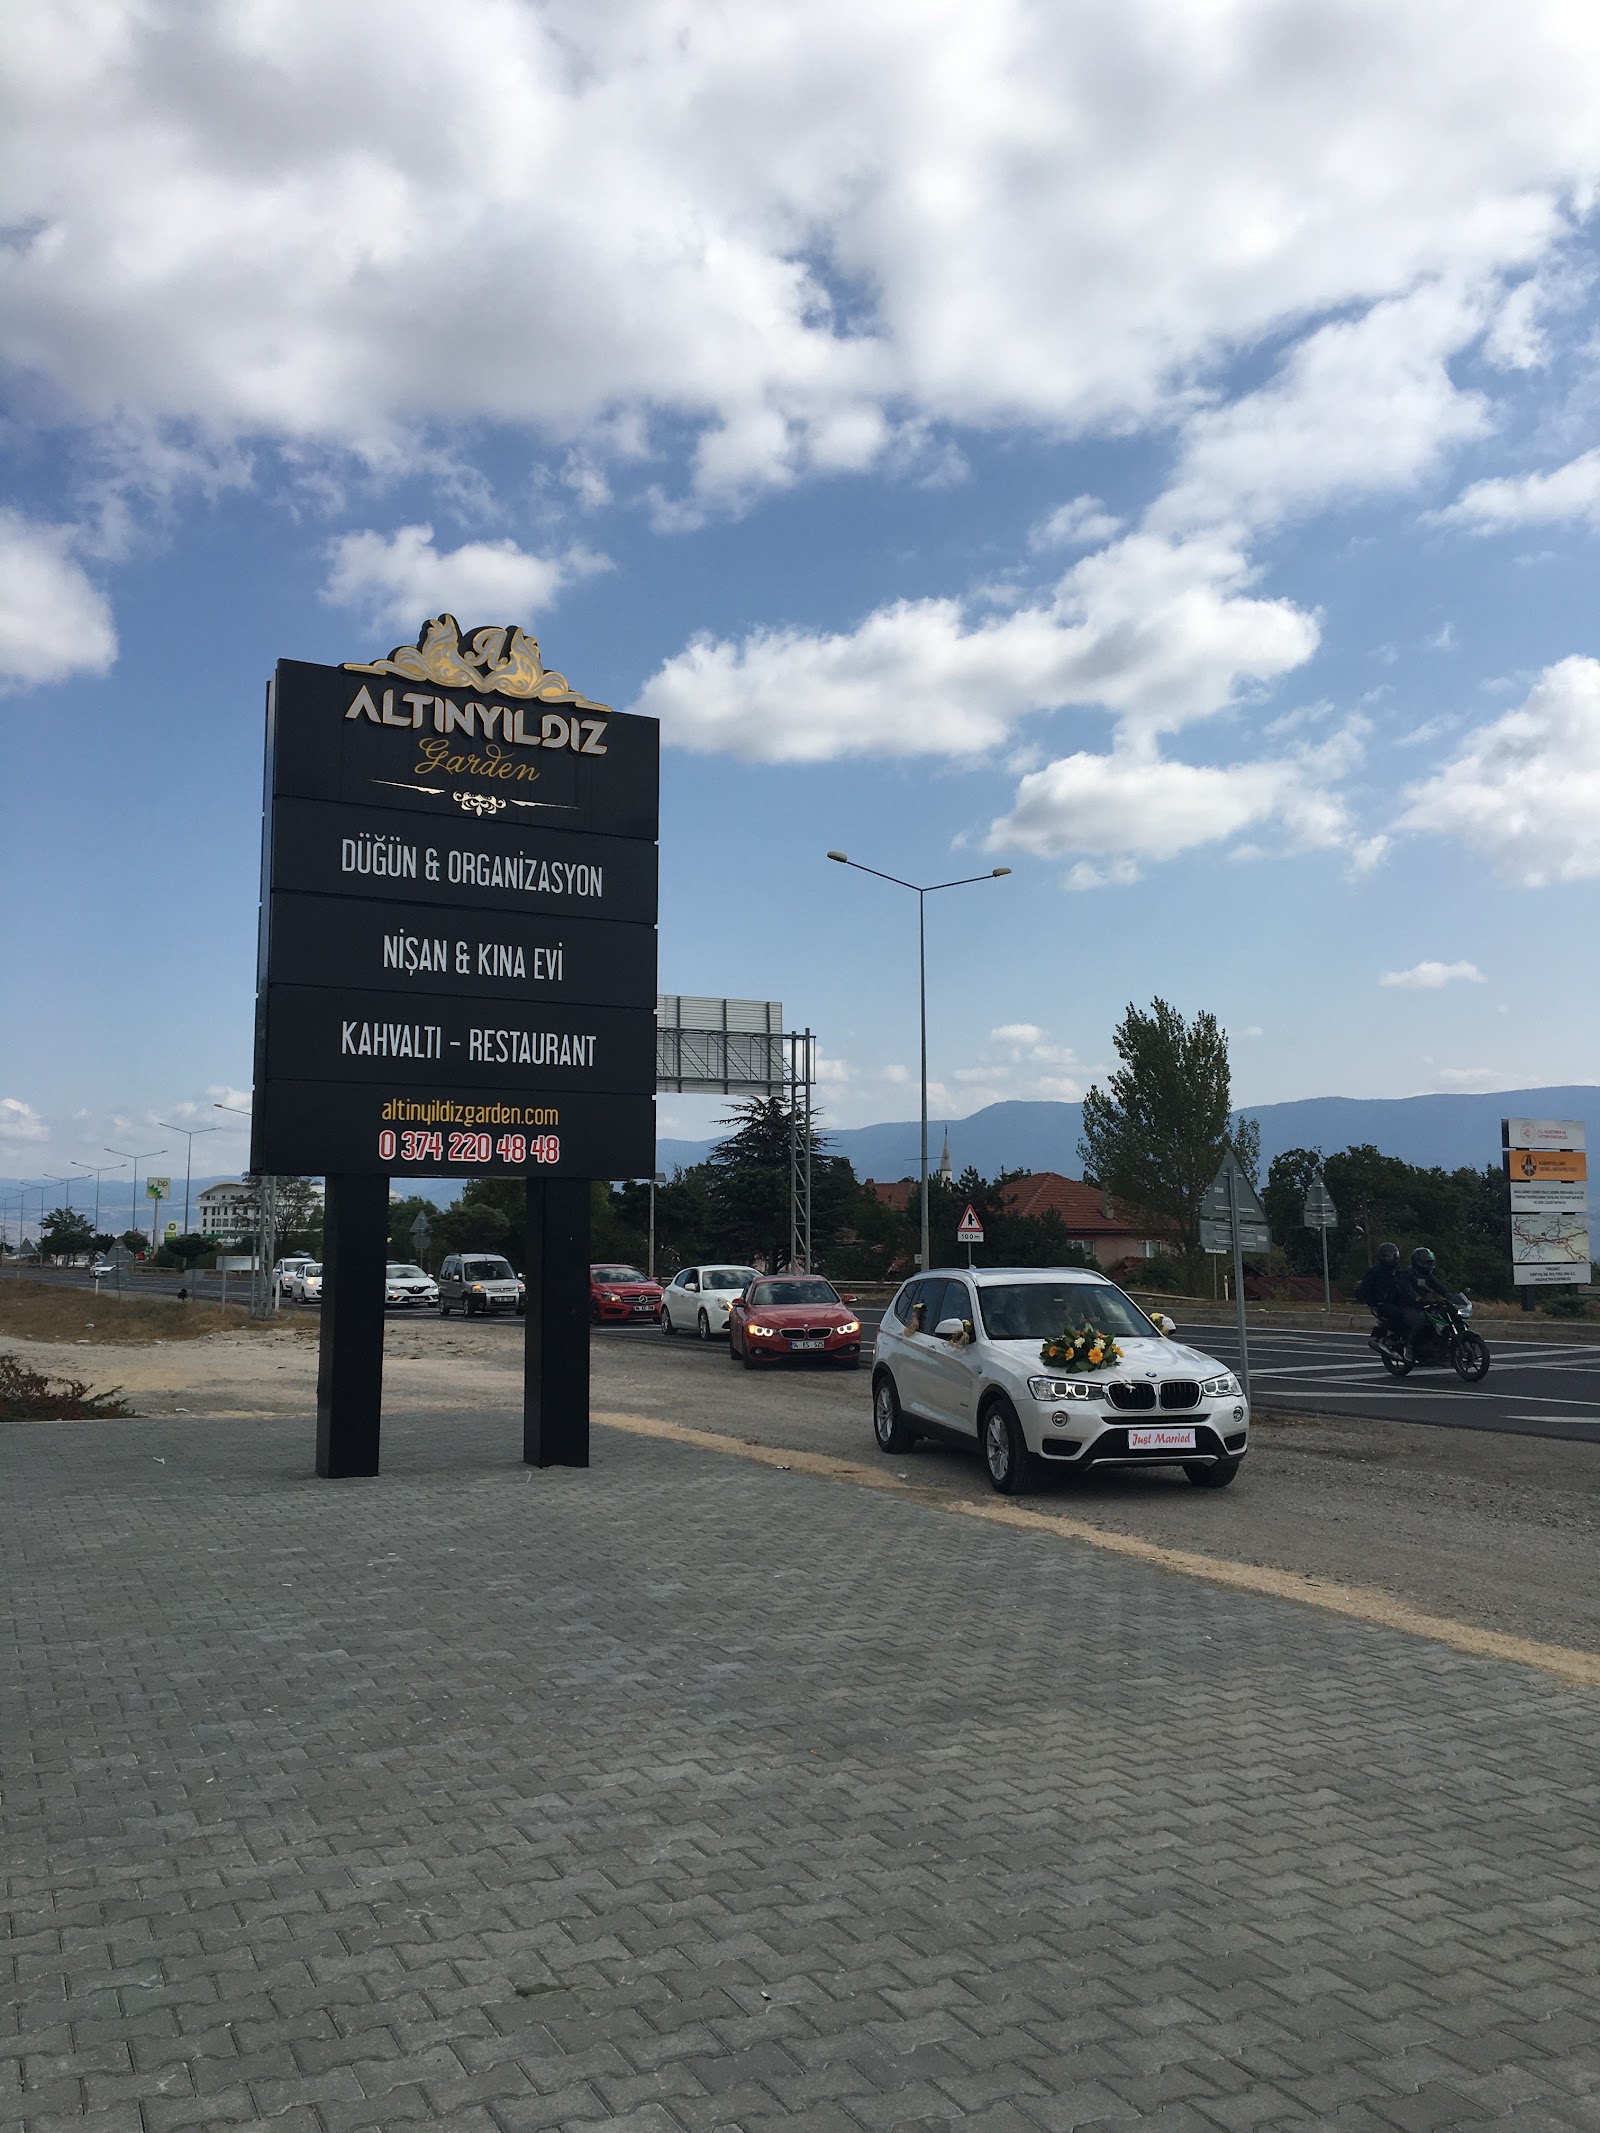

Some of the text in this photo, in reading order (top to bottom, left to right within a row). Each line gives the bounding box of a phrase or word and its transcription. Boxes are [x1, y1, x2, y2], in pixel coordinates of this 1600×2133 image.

[345, 685, 608, 755] ALTINYILDIZ
[414, 737, 540, 782] Garden
[341, 832, 603, 898] DÜĞÜN & ORGANİZASYON
[383, 928, 563, 981] NİŞAN & KINA EVİ
[341, 1021, 441, 1060] KAHVALTI
[469, 1028, 597, 1067] RESTAURANT
[381, 1098, 559, 1127] altinyildizgarden.com
[379, 1130, 560, 1164] 0 374 220 48 48
[157, 1179, 168, 1187] bp
[1132, 1432, 1190, 1446] Just Married
